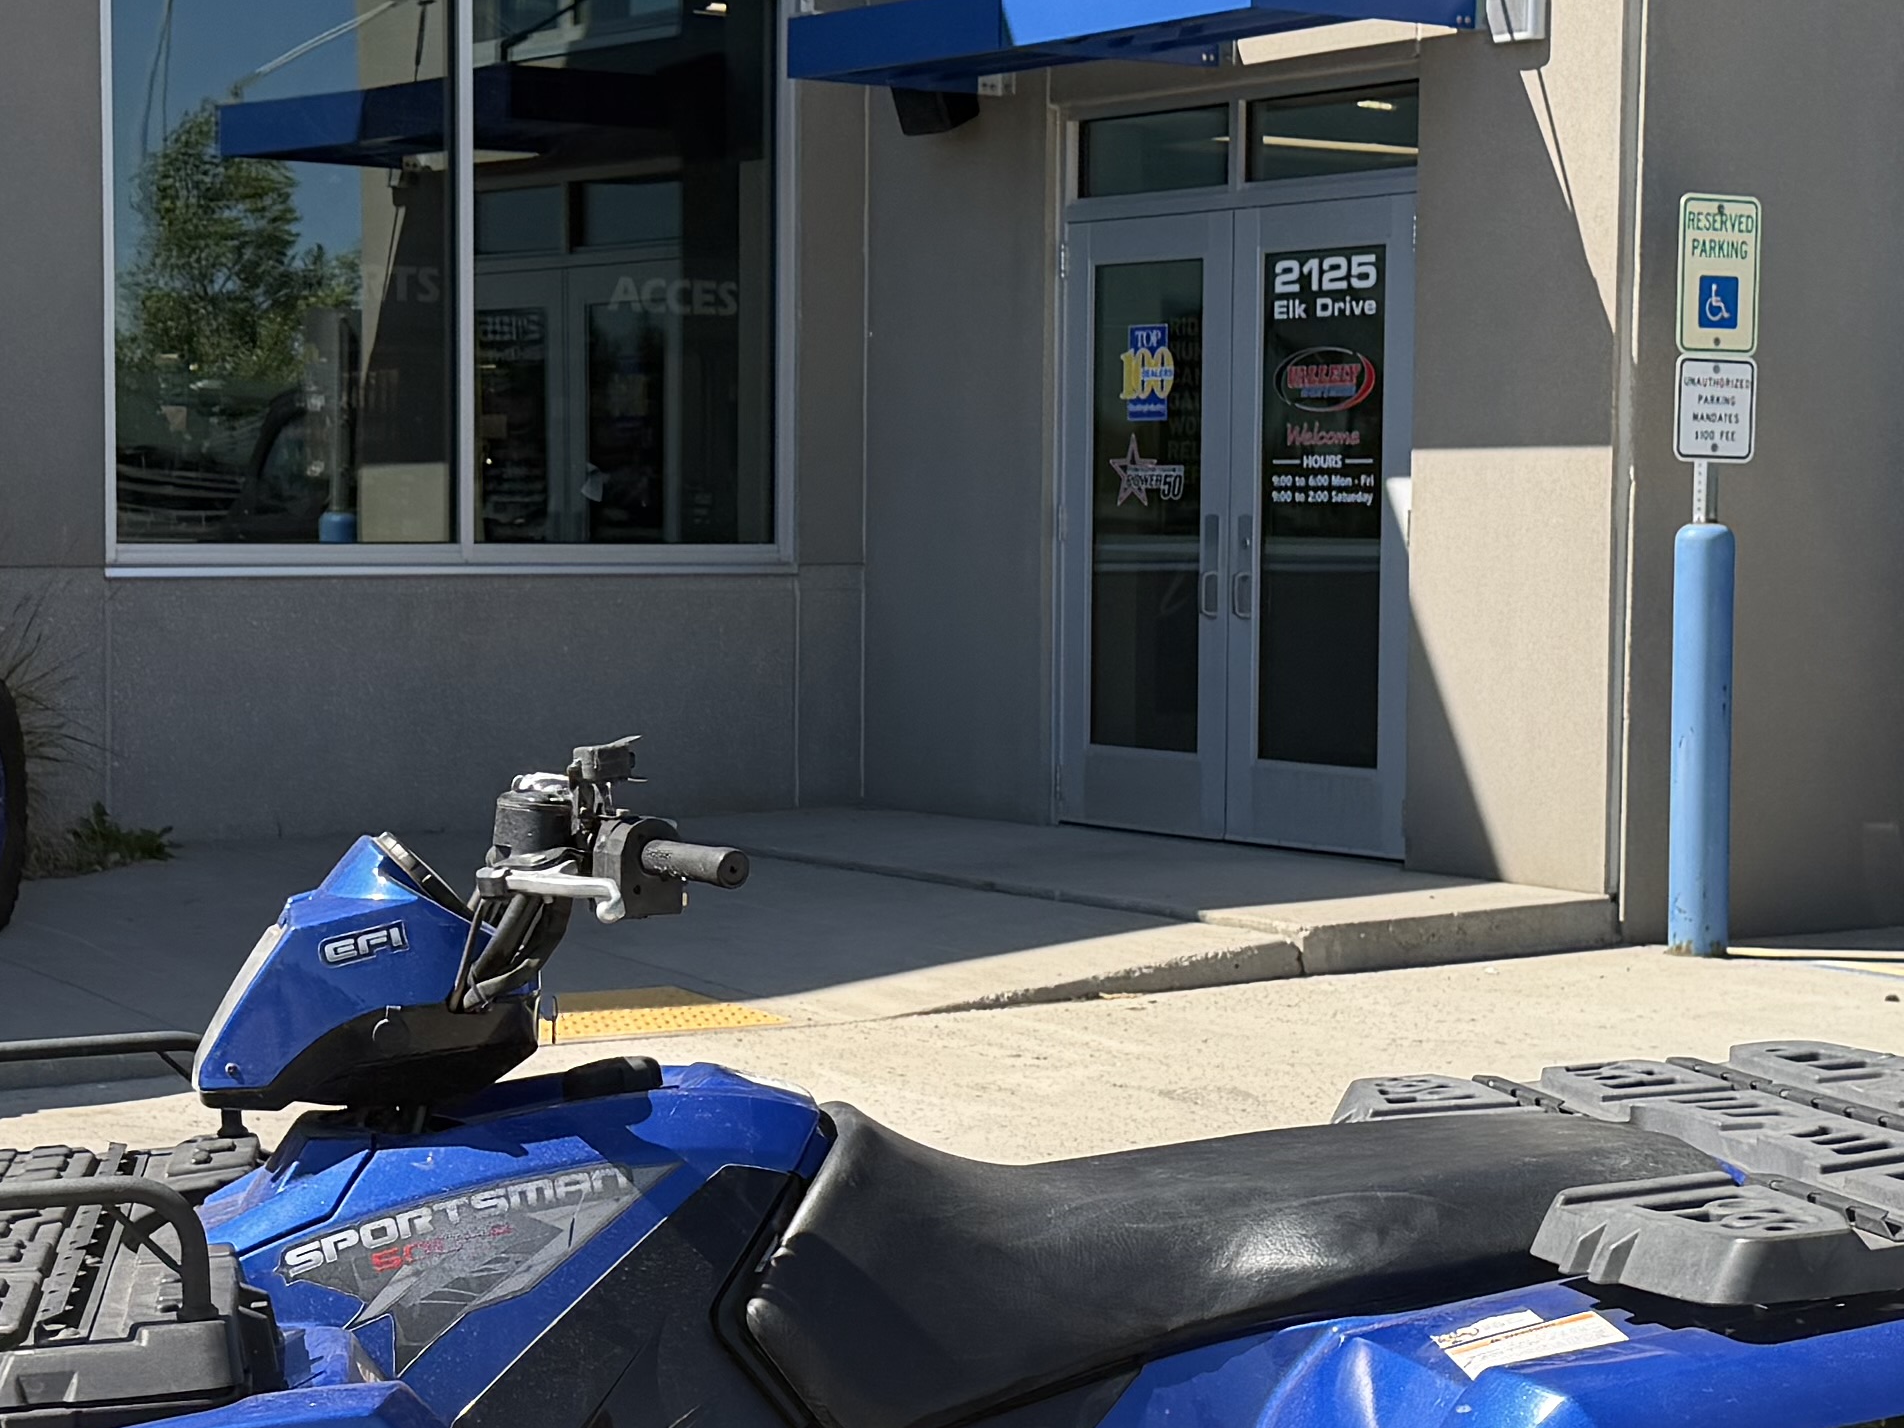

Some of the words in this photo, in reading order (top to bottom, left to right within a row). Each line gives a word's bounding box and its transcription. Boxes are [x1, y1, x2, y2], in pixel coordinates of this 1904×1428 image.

[1687, 211, 1754, 234] RESERVED
[1691, 239, 1748, 260] PARKING
[1274, 254, 1377, 294] 2125
[1274, 298, 1307, 320] Elk
[1316, 295, 1377, 318] Drive
[1135, 329, 1161, 348] TOP
[1120, 346, 1174, 400] 100
[1684, 376, 1751, 390] UNAUTHORIZED
[1697, 394, 1737, 406] PARKING
[1692, 412, 1740, 424] MANDATES
[1286, 420, 1361, 446] Welcome
[1719, 430, 1736, 442] FEE
[1302, 455, 1343, 469] HOURS
[1161, 473, 1183, 499] 50
[1295, 476, 1306, 487] to
[1331, 475, 1352, 487] Mon
[1295, 491, 1306, 503] to
[1331, 490, 1374, 506] Saturday
[323, 921, 406, 966] EFI
[284, 1167, 629, 1278] SPORTSMAN
